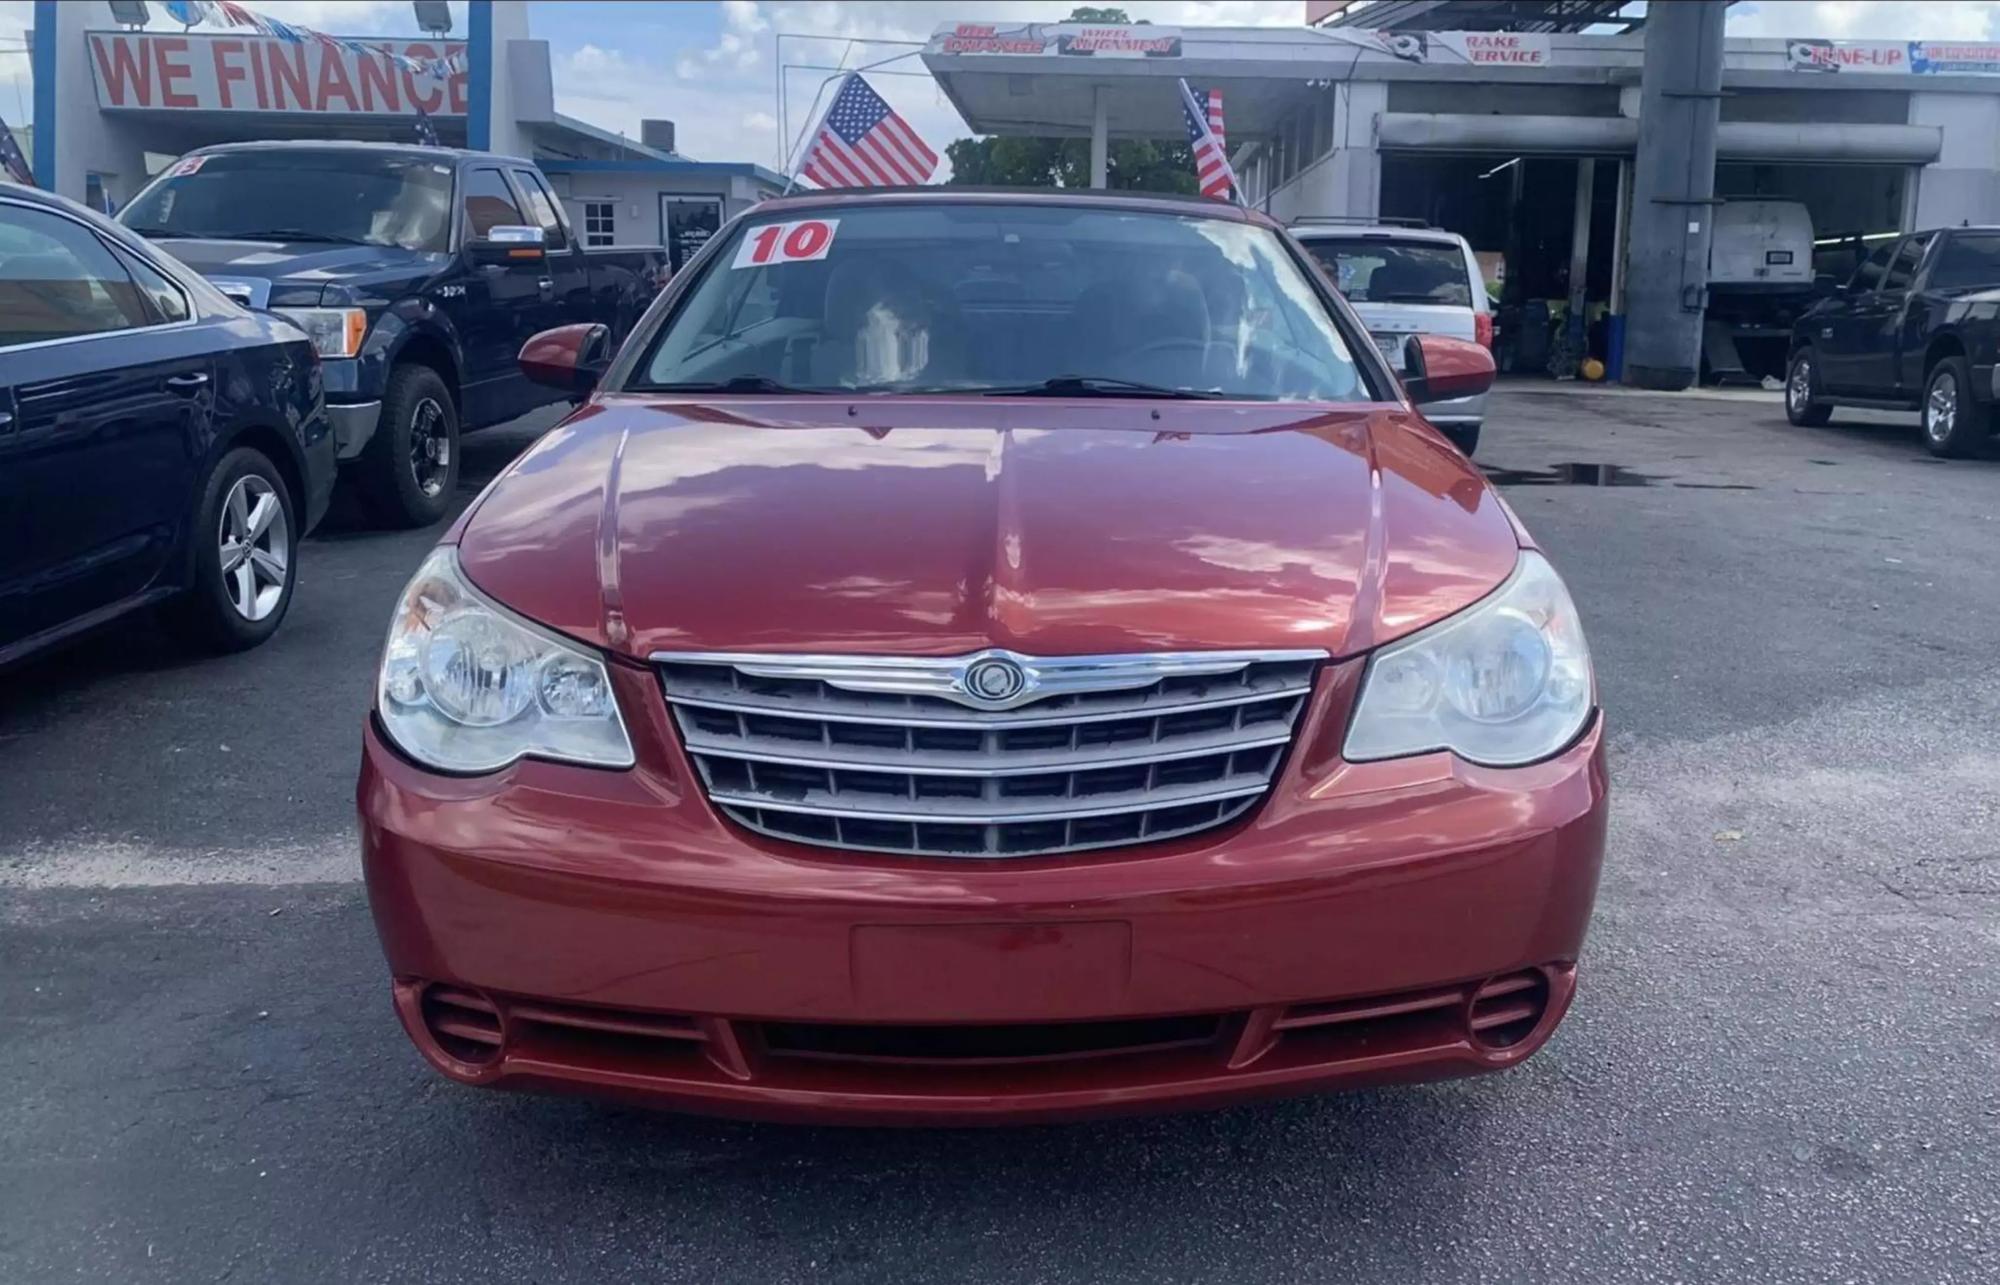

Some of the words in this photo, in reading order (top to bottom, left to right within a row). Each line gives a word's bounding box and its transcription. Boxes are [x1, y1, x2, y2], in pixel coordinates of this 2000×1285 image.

[1082, 29, 1129, 37] WHEEL
[1466, 36, 1519, 47] RAKE
[1811, 47, 1902, 65] TUNE-UP
[91, 37, 198, 108] WE
[752, 222, 832, 263] 10
